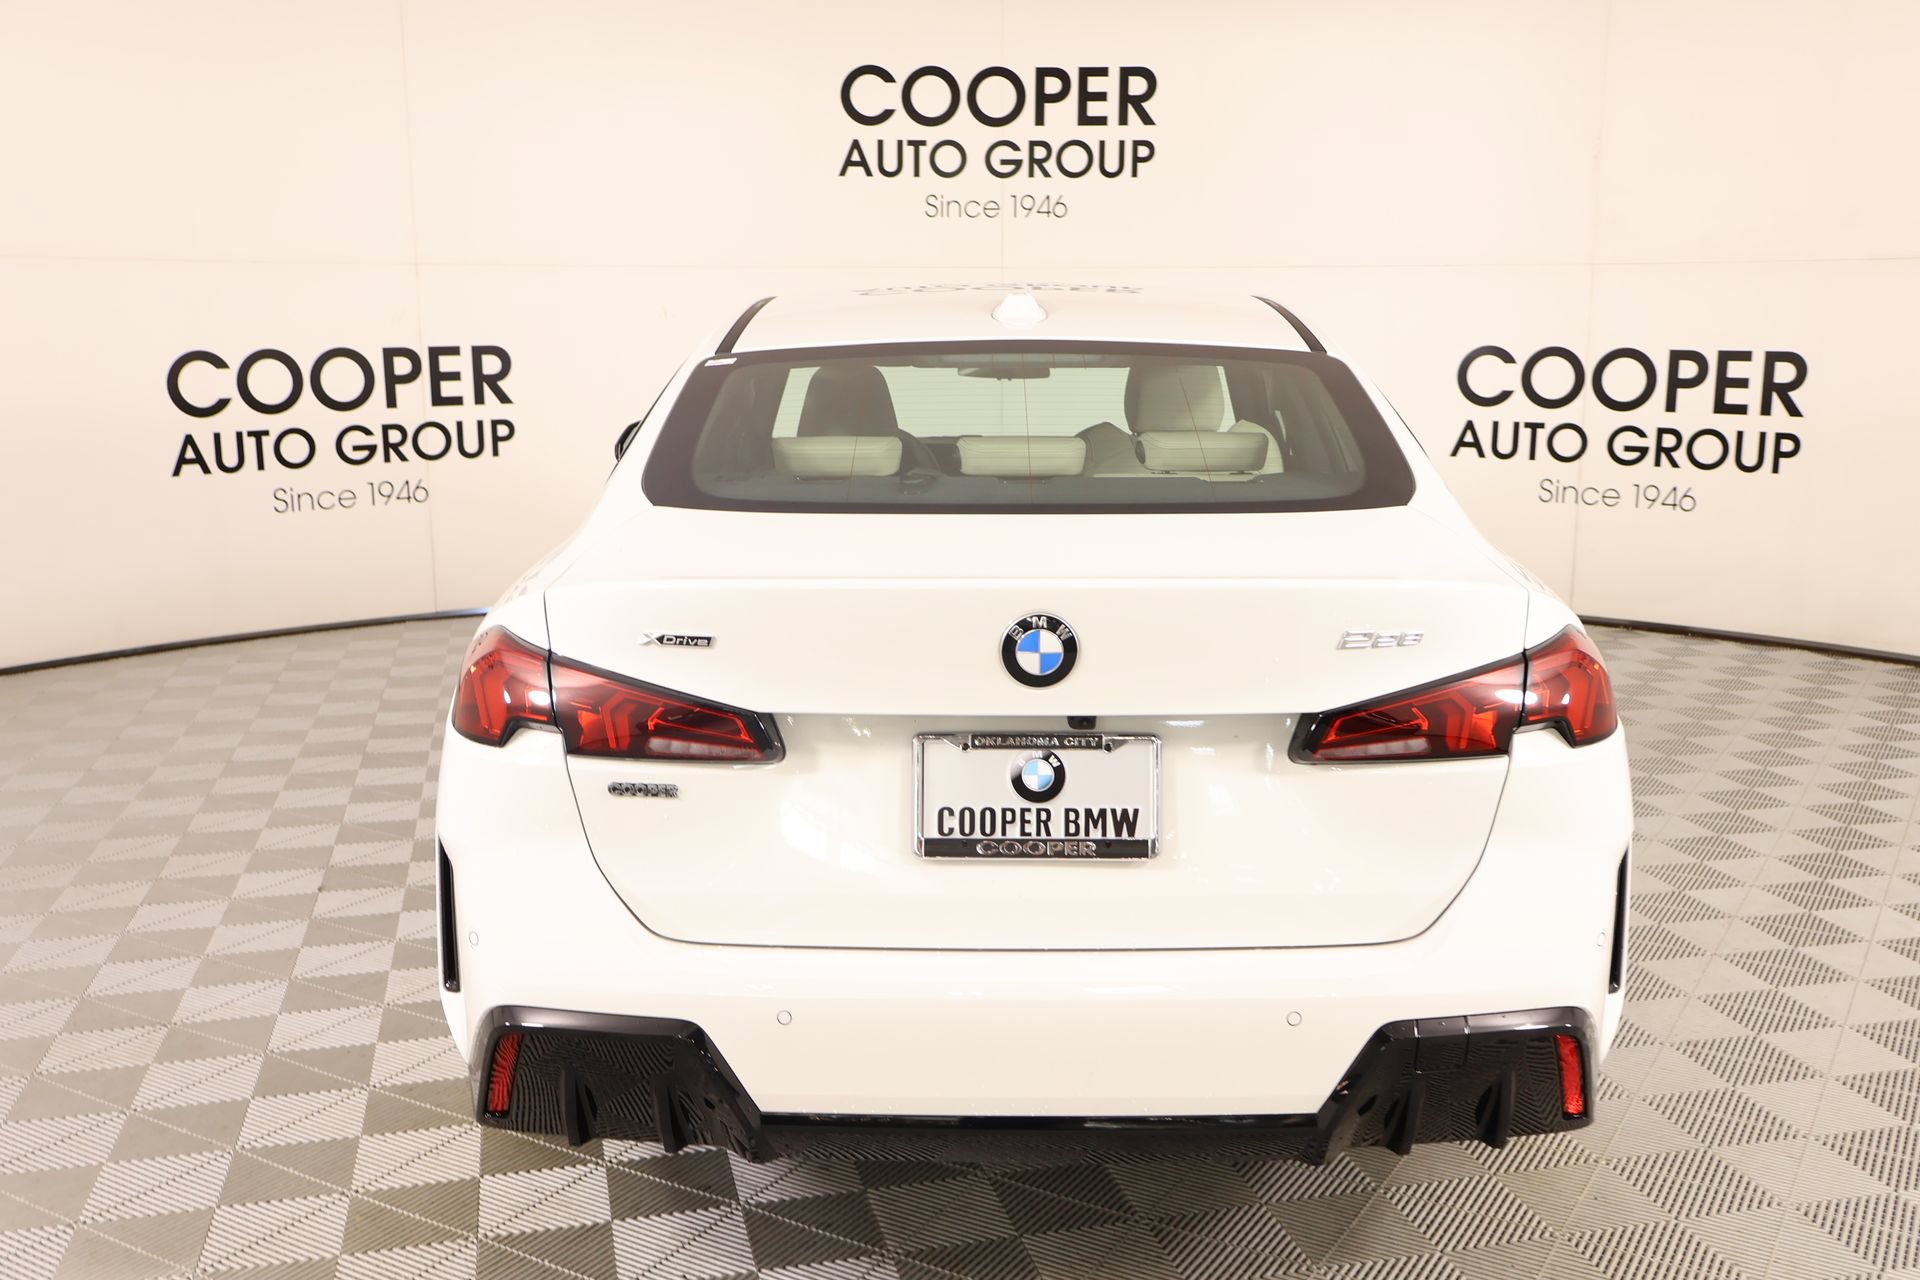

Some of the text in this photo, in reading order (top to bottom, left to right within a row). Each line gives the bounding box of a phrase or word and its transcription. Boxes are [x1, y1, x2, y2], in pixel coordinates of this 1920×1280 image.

[841, 64, 1158, 128] COOPER
[838, 138, 1156, 179] AUTO GROUP
[924, 193, 1069, 219] Since 1946
[166, 345, 515, 418] COOPER
[1457, 345, 1808, 418] COOPER
[172, 419, 515, 477] AUTO GROUP
[1449, 420, 1801, 474] AUTO GROUP
[273, 478, 430, 514] Since 1946
[1538, 478, 1697, 512] Since 1946
[1007, 615, 1073, 643] BMW
[974, 736, 1099, 748] OKLAHOMA CITY
[937, 806, 1139, 837] COOPER BMW
[975, 840, 1097, 856] COOPER
